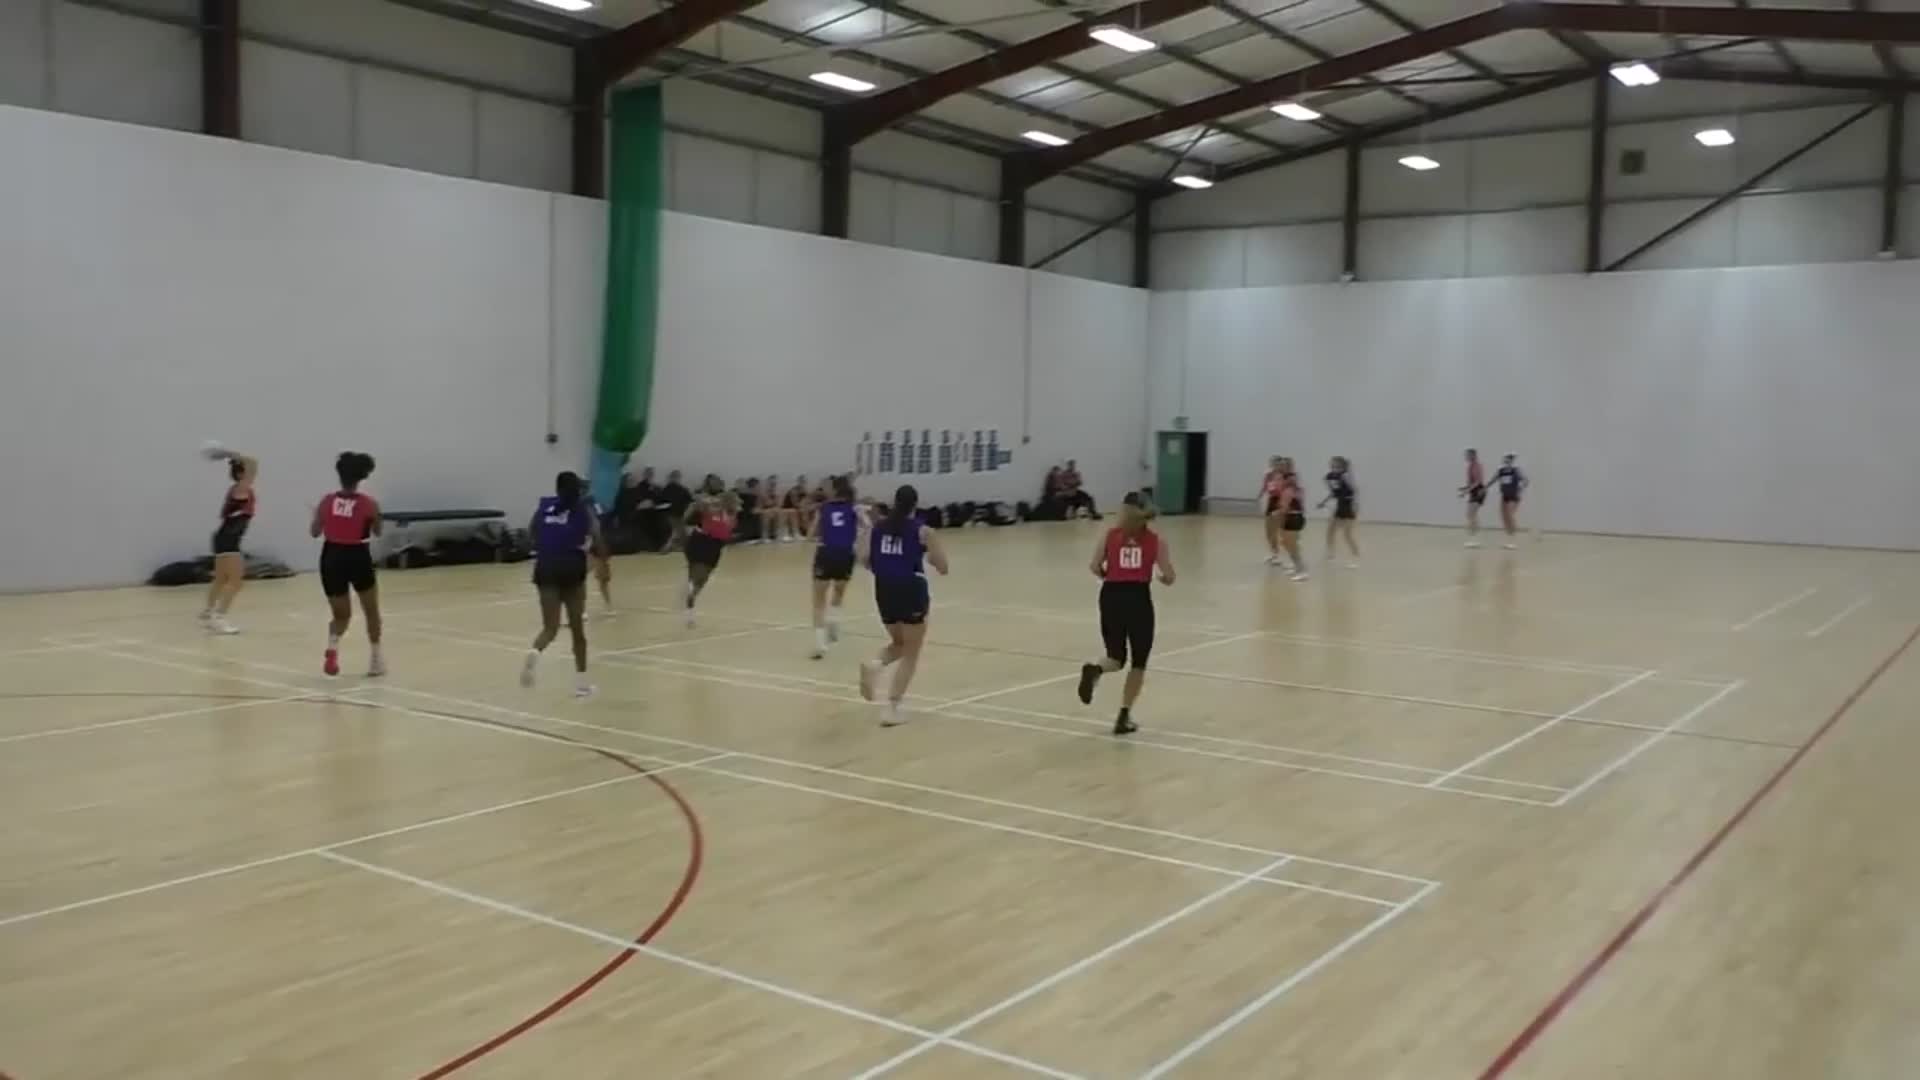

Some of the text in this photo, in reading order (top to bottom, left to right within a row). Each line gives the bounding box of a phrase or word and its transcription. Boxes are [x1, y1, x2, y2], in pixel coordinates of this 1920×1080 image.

[332, 497, 357, 518] GK
[880, 534, 904, 555] GA
[1119, 546, 1143, 569] GD
